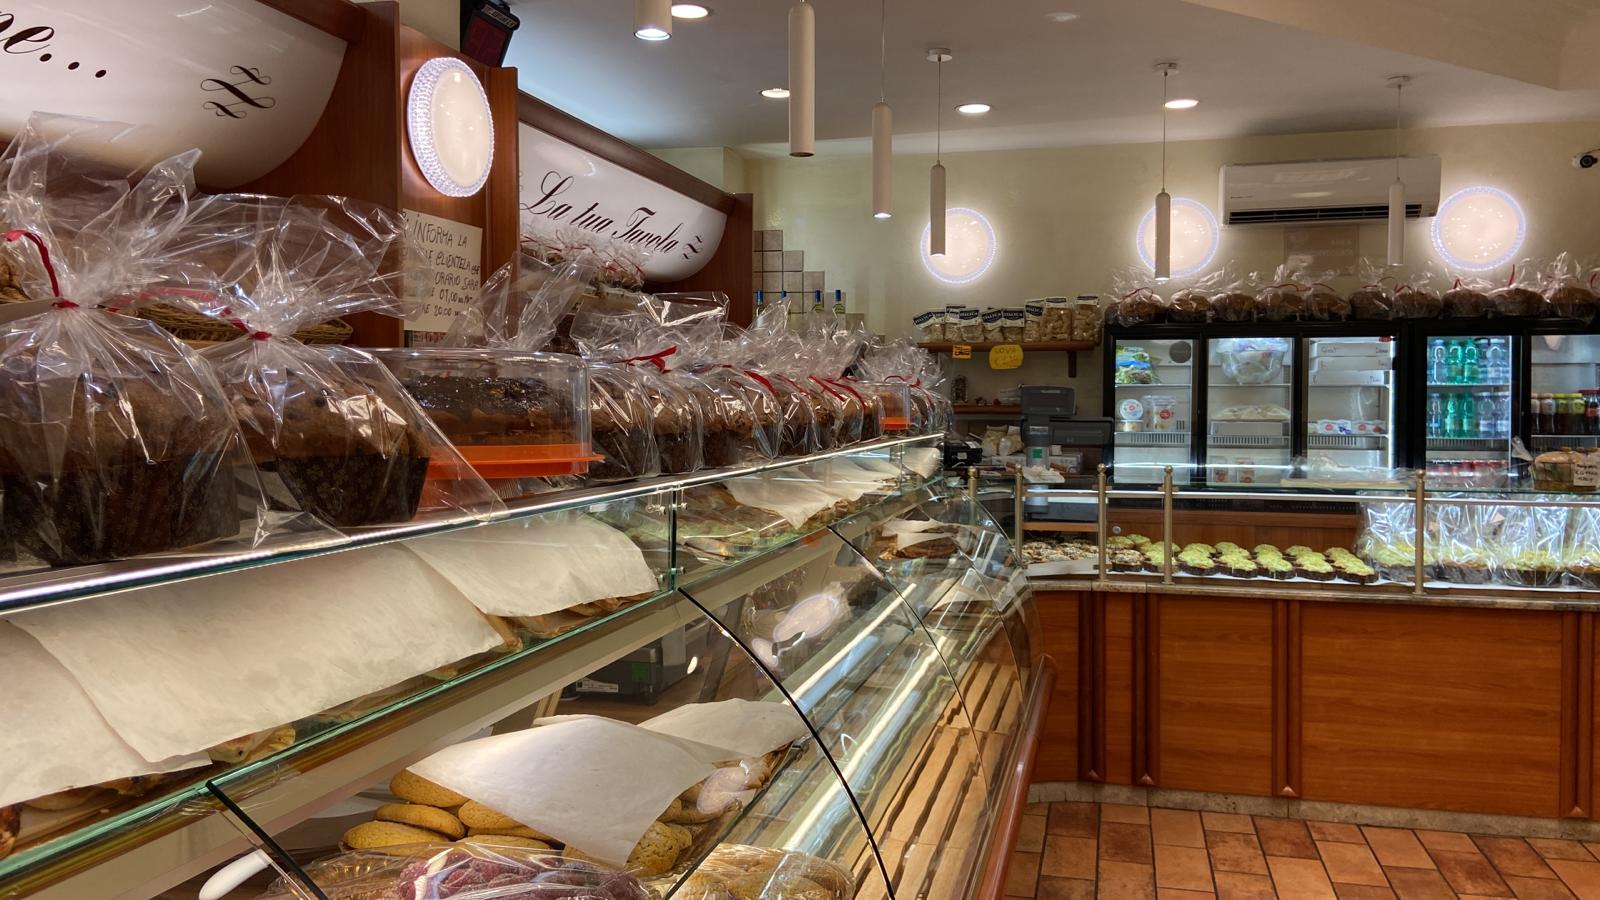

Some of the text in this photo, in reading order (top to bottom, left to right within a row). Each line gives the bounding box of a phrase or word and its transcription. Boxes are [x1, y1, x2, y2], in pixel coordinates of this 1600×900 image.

[520, 171, 684, 253] La tua Tavola
[457, 234, 468, 248] LA
